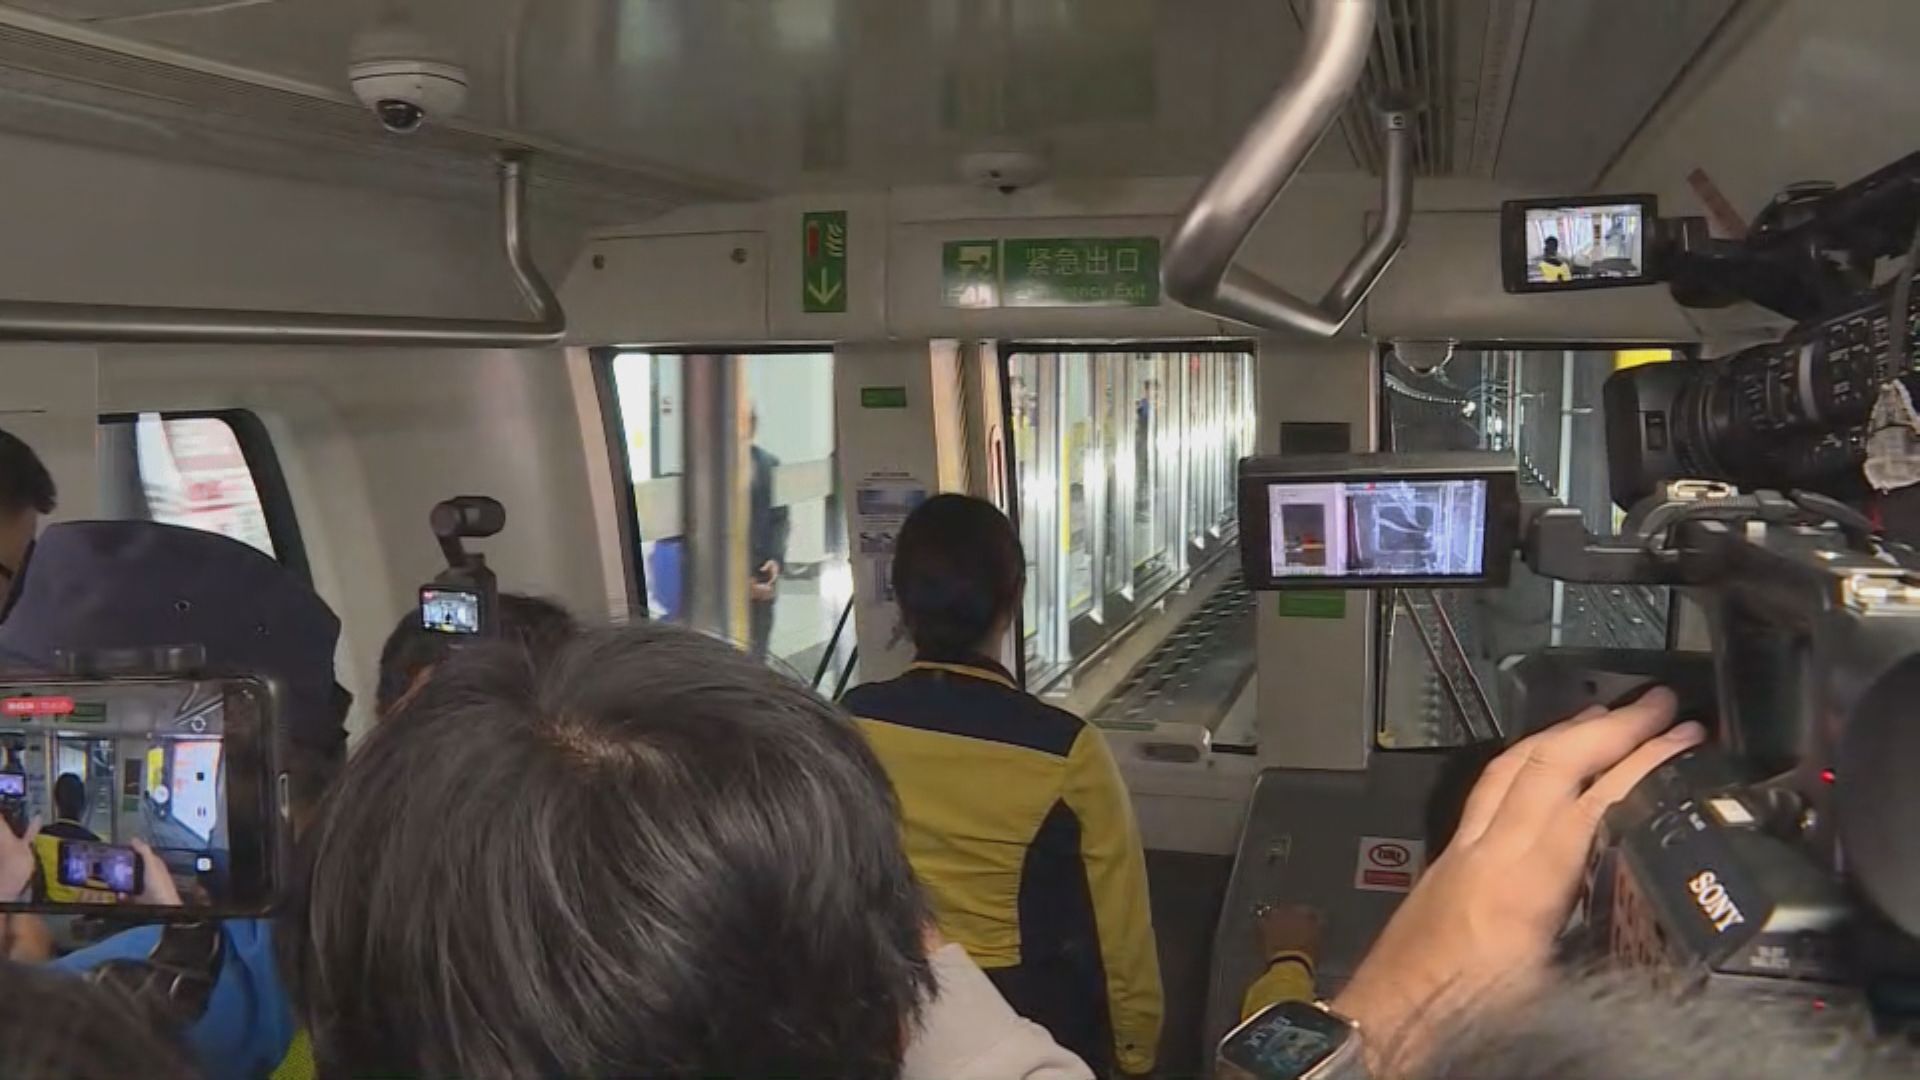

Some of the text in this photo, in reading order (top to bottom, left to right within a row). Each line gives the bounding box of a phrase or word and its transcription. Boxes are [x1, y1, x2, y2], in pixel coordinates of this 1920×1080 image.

[1026, 247, 1139, 276] 紧急出口
[1688, 870, 1745, 932] SONY
